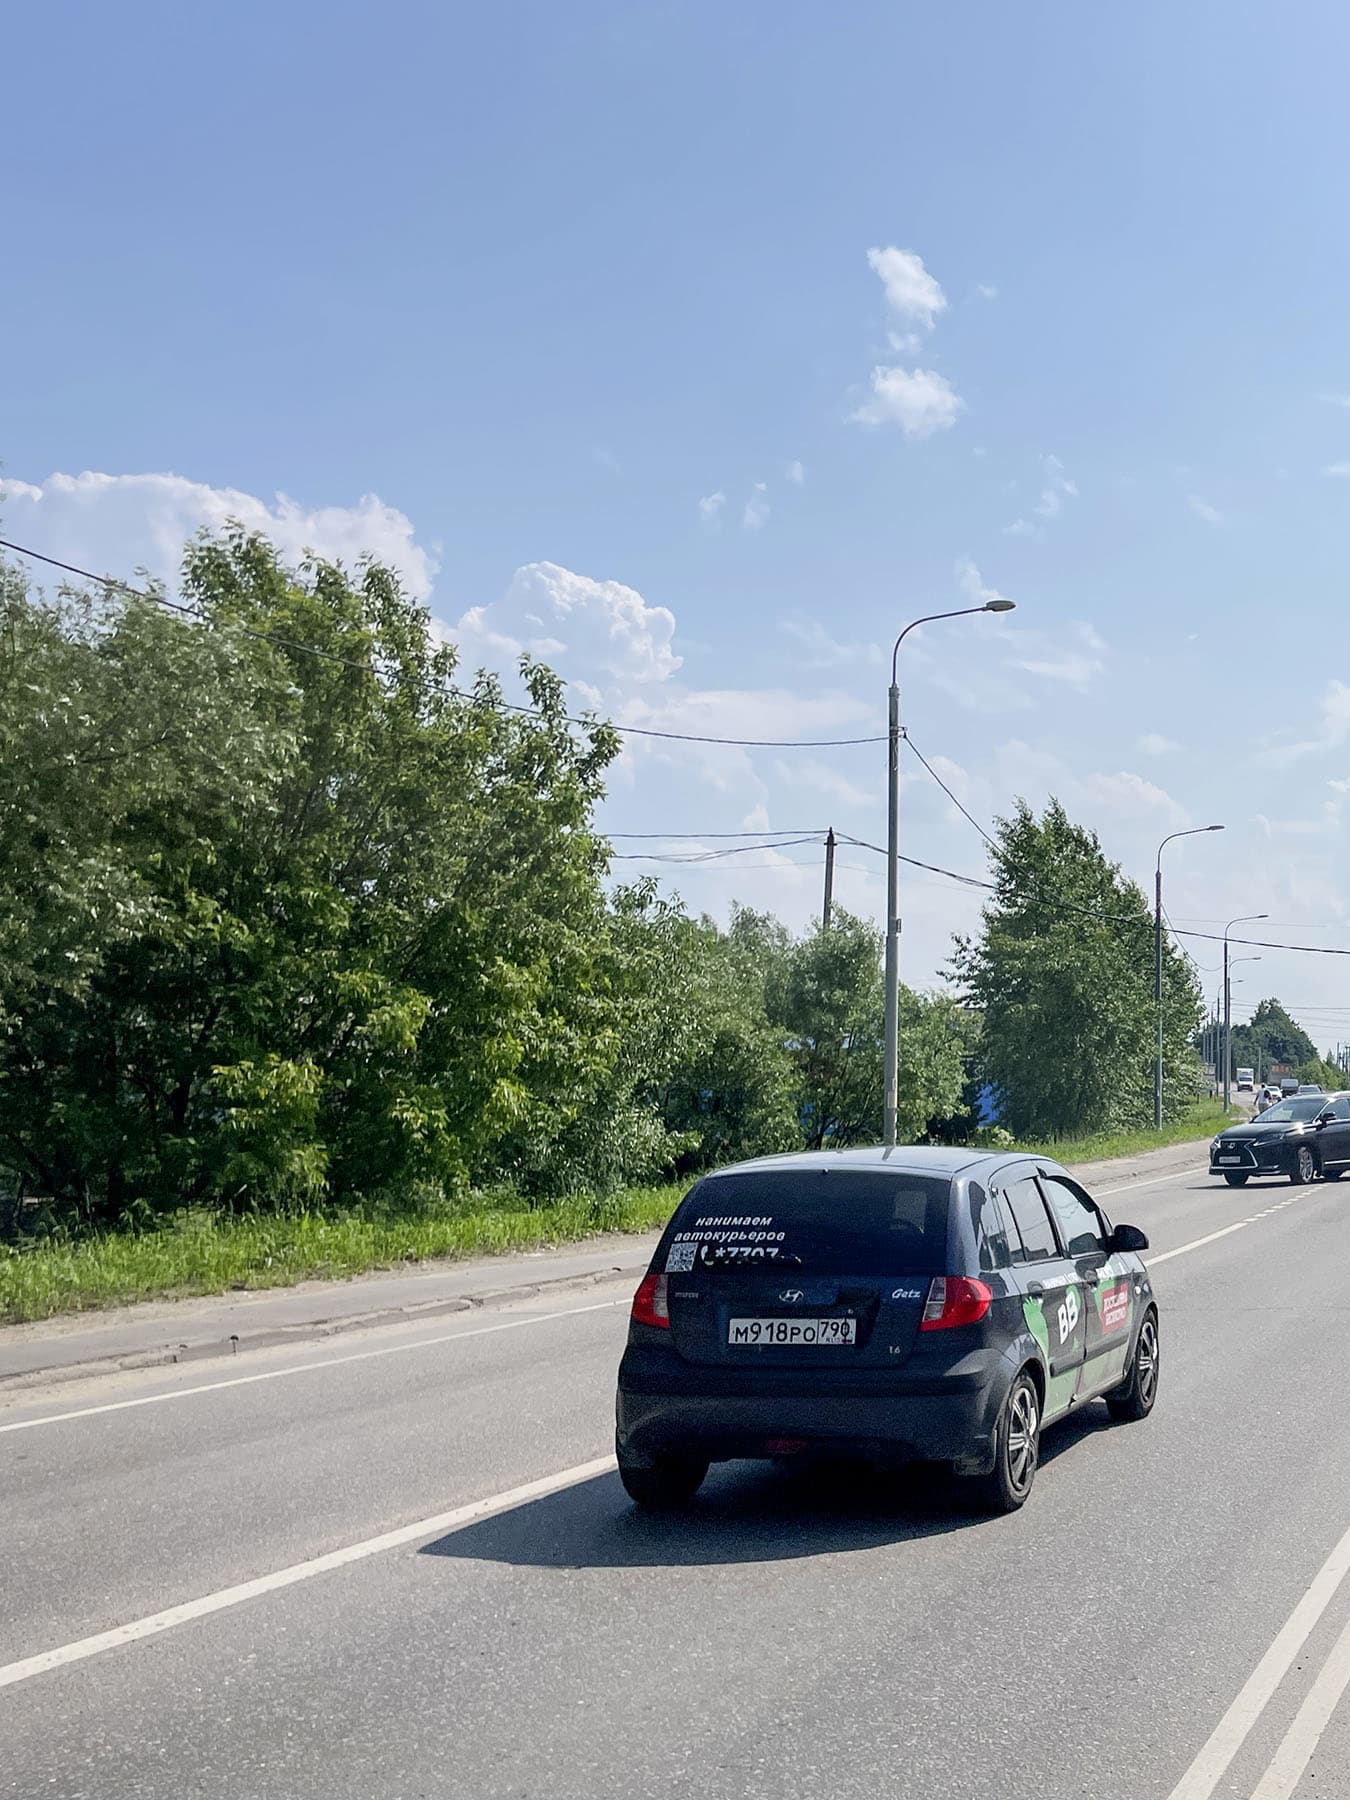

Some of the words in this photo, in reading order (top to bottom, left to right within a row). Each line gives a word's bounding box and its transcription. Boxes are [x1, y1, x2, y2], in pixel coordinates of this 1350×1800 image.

[695, 1216, 773, 1226] нанимаем
[674, 1231, 786, 1243] автокурьеров
[892, 1288, 921, 1299] Getz
